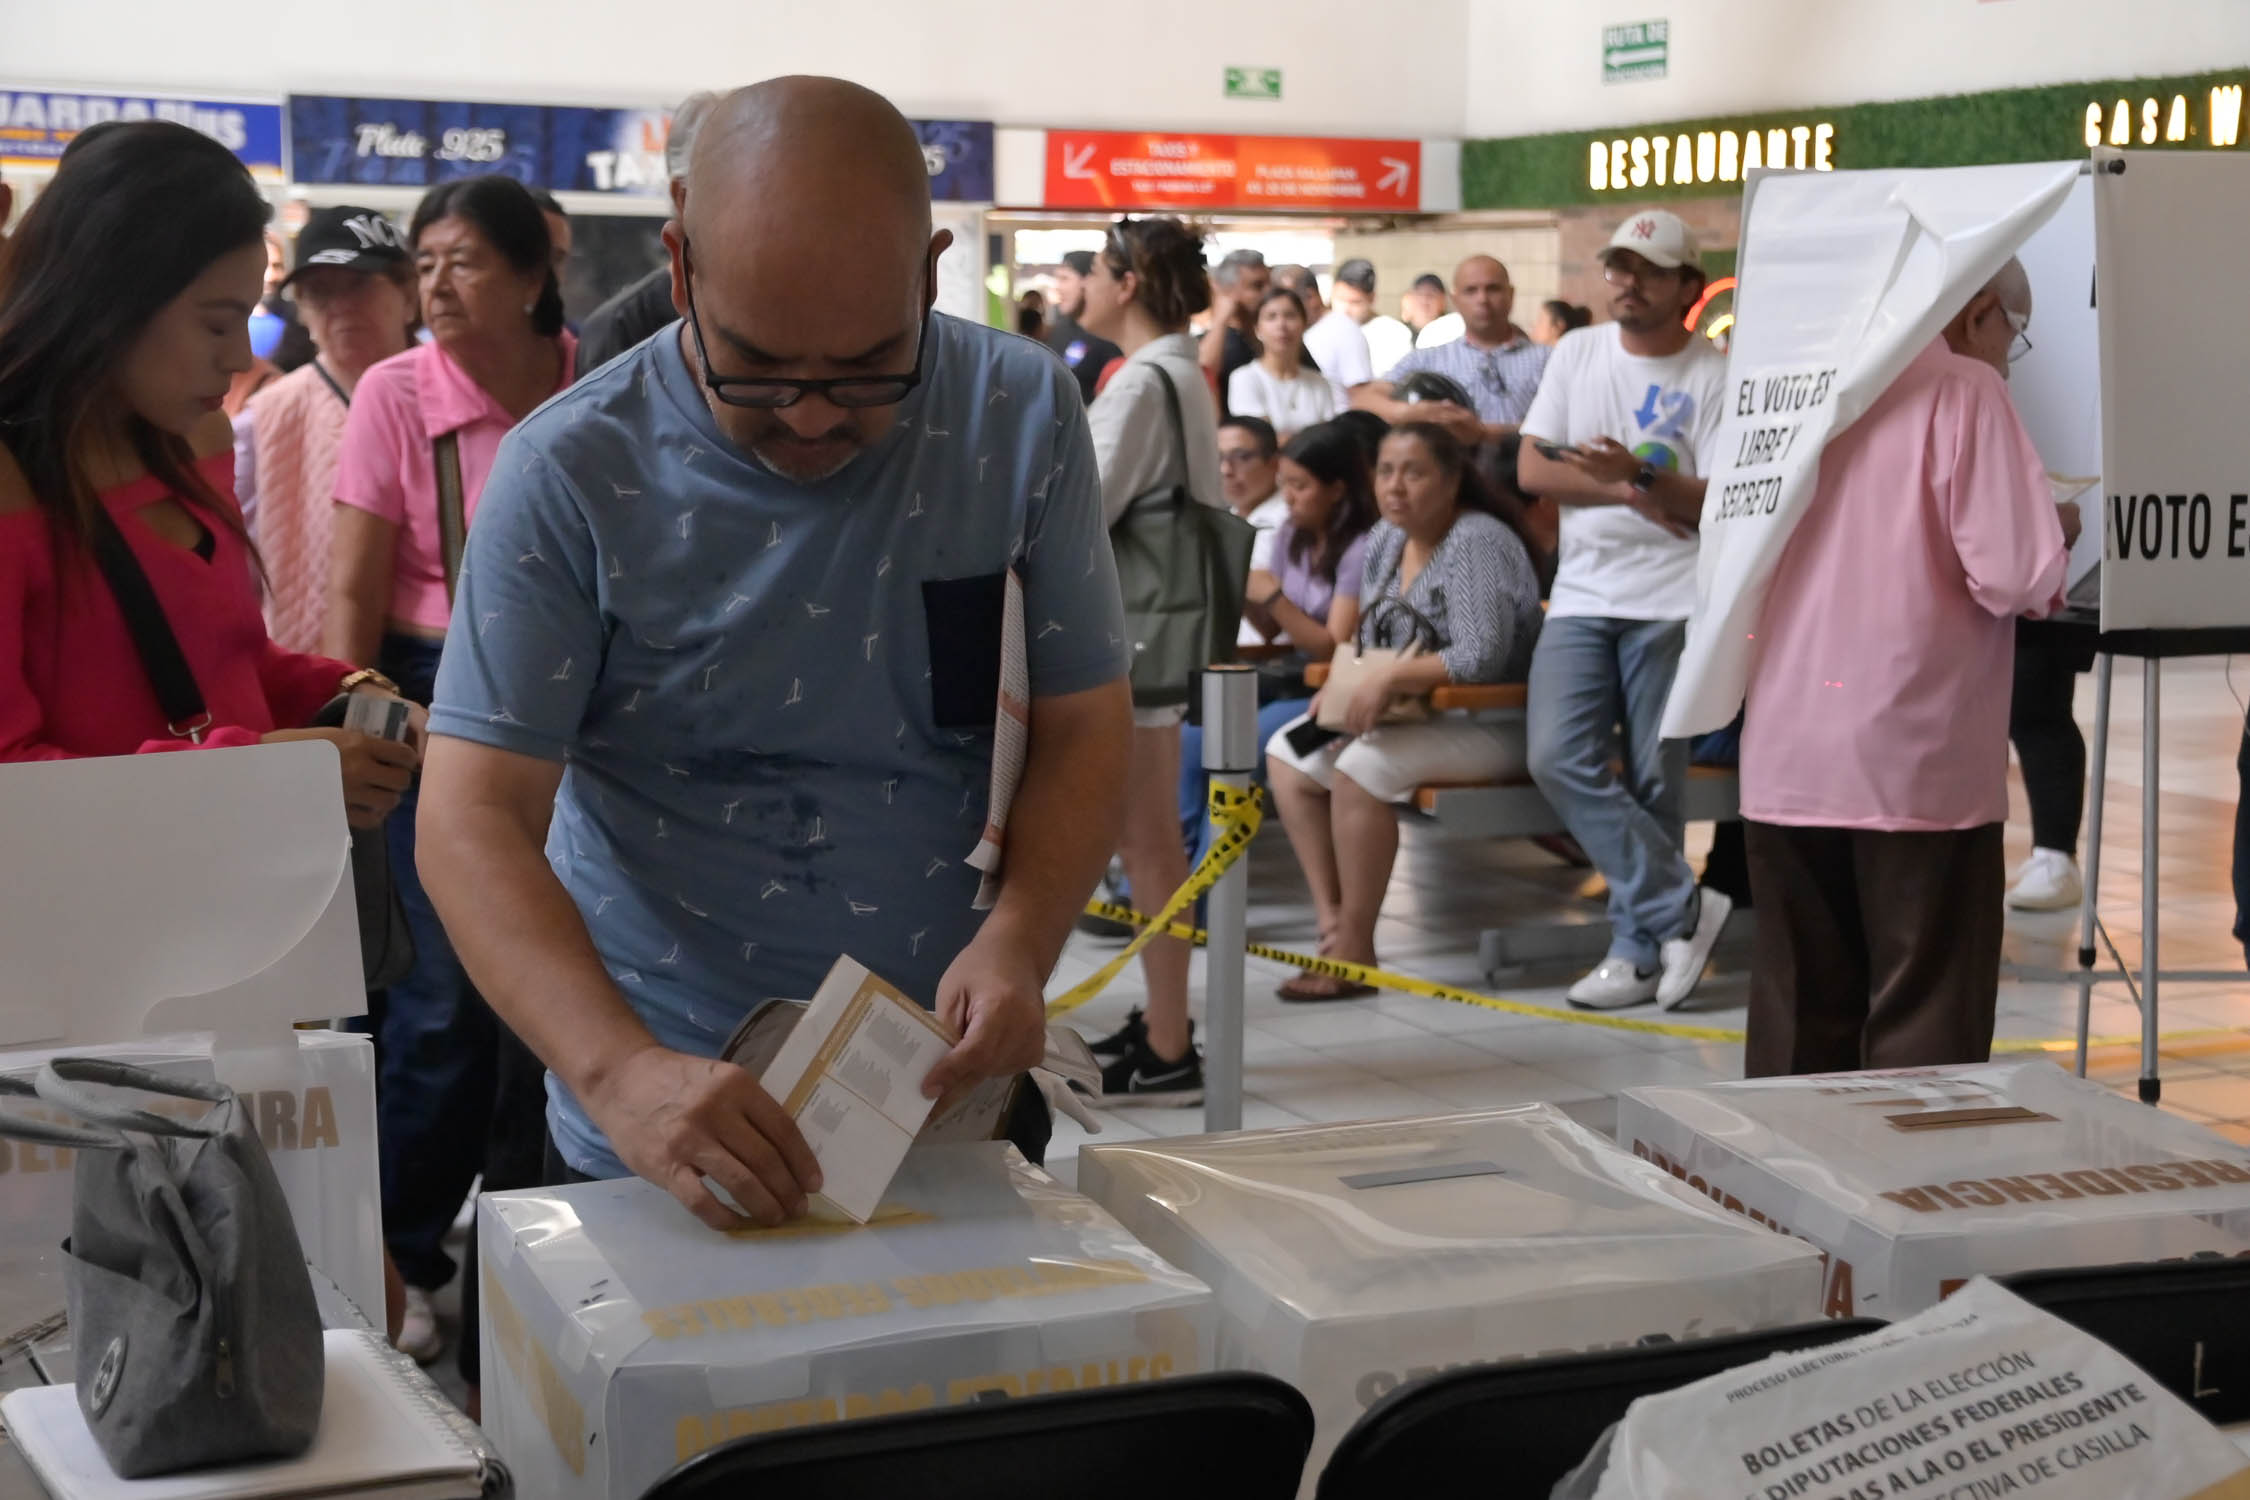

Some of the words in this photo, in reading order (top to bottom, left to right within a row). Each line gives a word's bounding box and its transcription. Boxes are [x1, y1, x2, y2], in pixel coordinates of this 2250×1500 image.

[1590, 123, 1834, 190] RESTAURANTE
[1737, 379, 1756, 416] EL
[1763, 374, 1812, 414] VOTO
[1734, 427, 1789, 469] LIBRE
[1715, 476, 1782, 522] SECRETO
[2114, 494, 2211, 561] VOTO
[1741, 1413, 1855, 1476] BOLETAS
[1854, 1397, 1893, 1429] DE
[1891, 1387, 1928, 1413] LA
[1925, 1350, 2036, 1400] ELECCIÓN
[1764, 1415, 1951, 1500] DIPUTACIONES
[1950, 1371, 2084, 1430] FEDERALES
[1887, 1471, 1909, 1493] A
[1905, 1458, 1945, 1486] LA
[1944, 1450, 1966, 1472] O
[1965, 1438, 2001, 1464] EL
[1998, 1383, 2148, 1452] PRESIDENTE
[2017, 1457, 2058, 1486] DE
[2056, 1423, 2153, 1471] CASILLA
